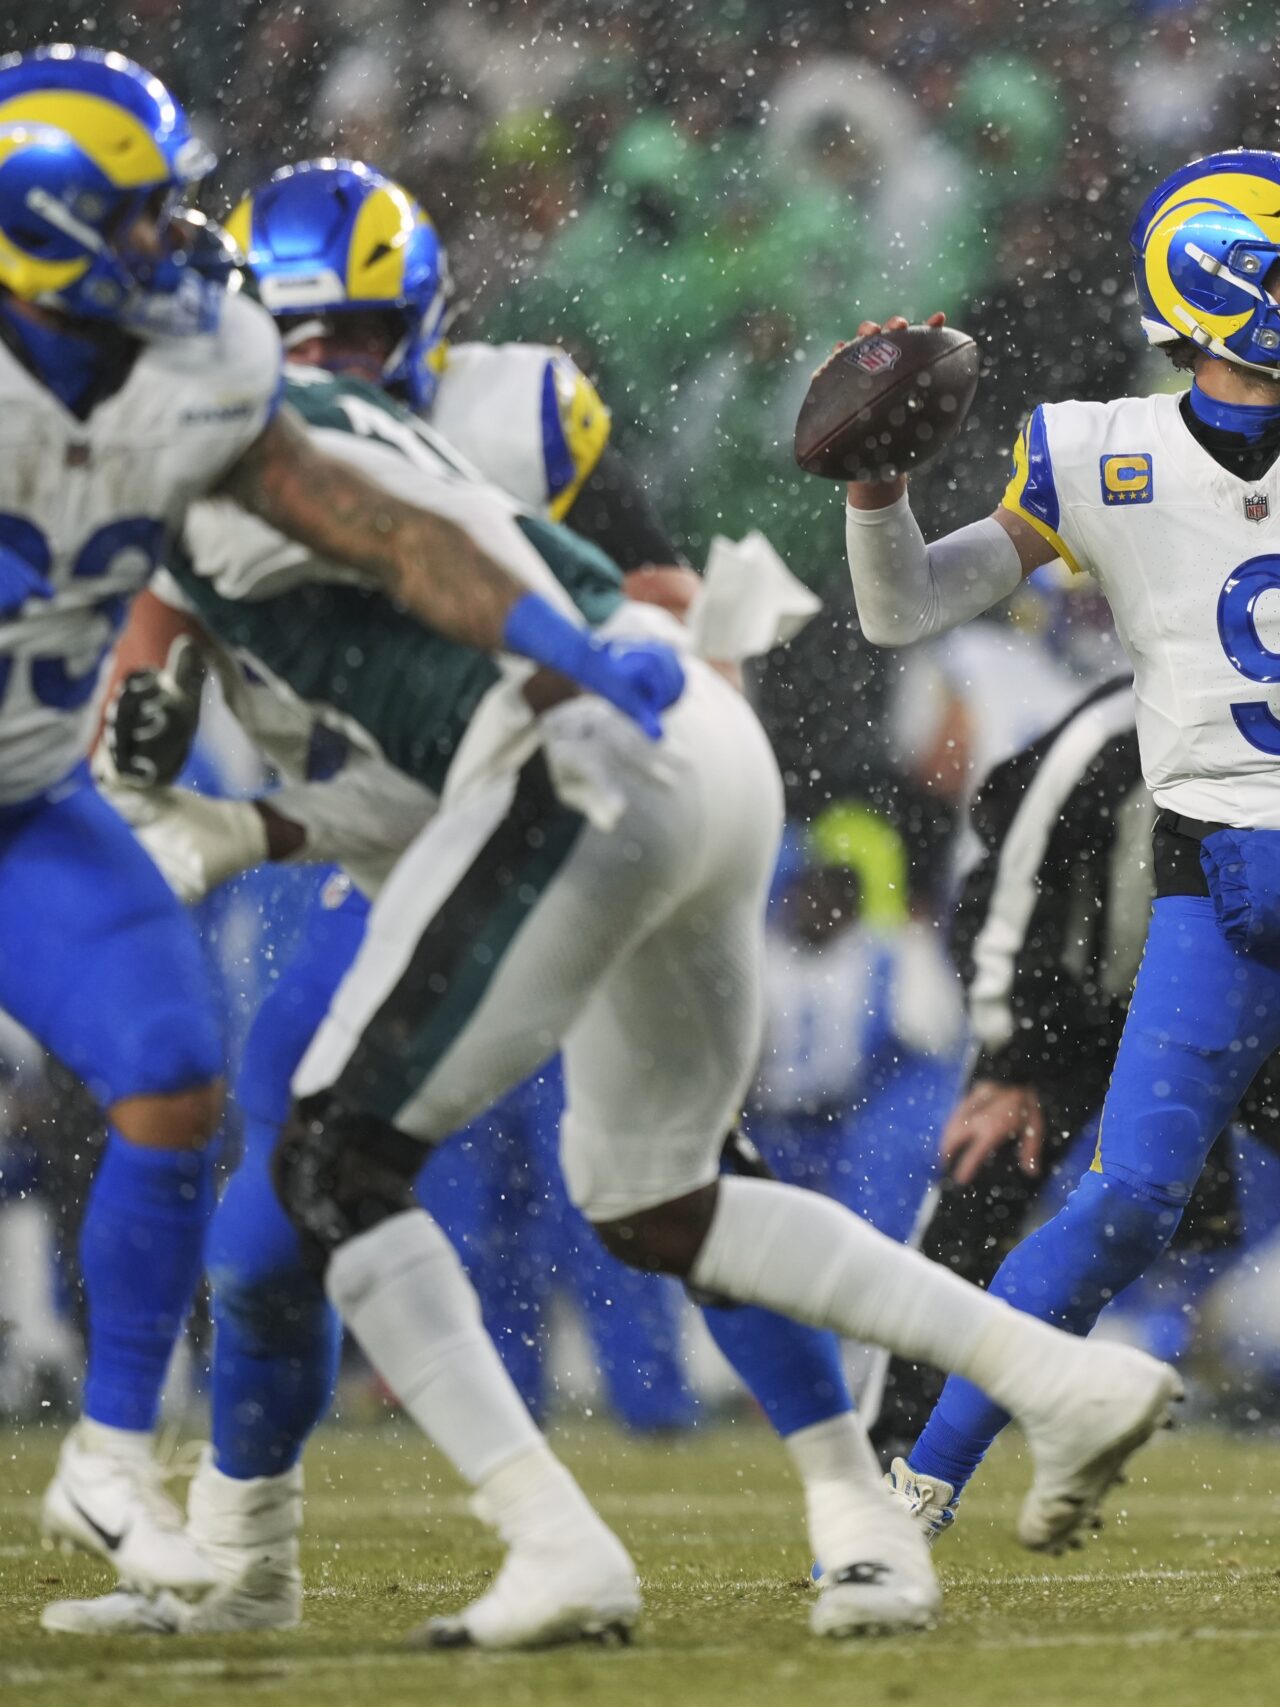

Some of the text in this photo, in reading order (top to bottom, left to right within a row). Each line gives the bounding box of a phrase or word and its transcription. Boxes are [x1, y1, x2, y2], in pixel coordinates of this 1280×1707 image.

[861, 344, 896, 370] NFL
[1104, 456, 1149, 492] C
[1248, 505, 1266, 518] NFL
